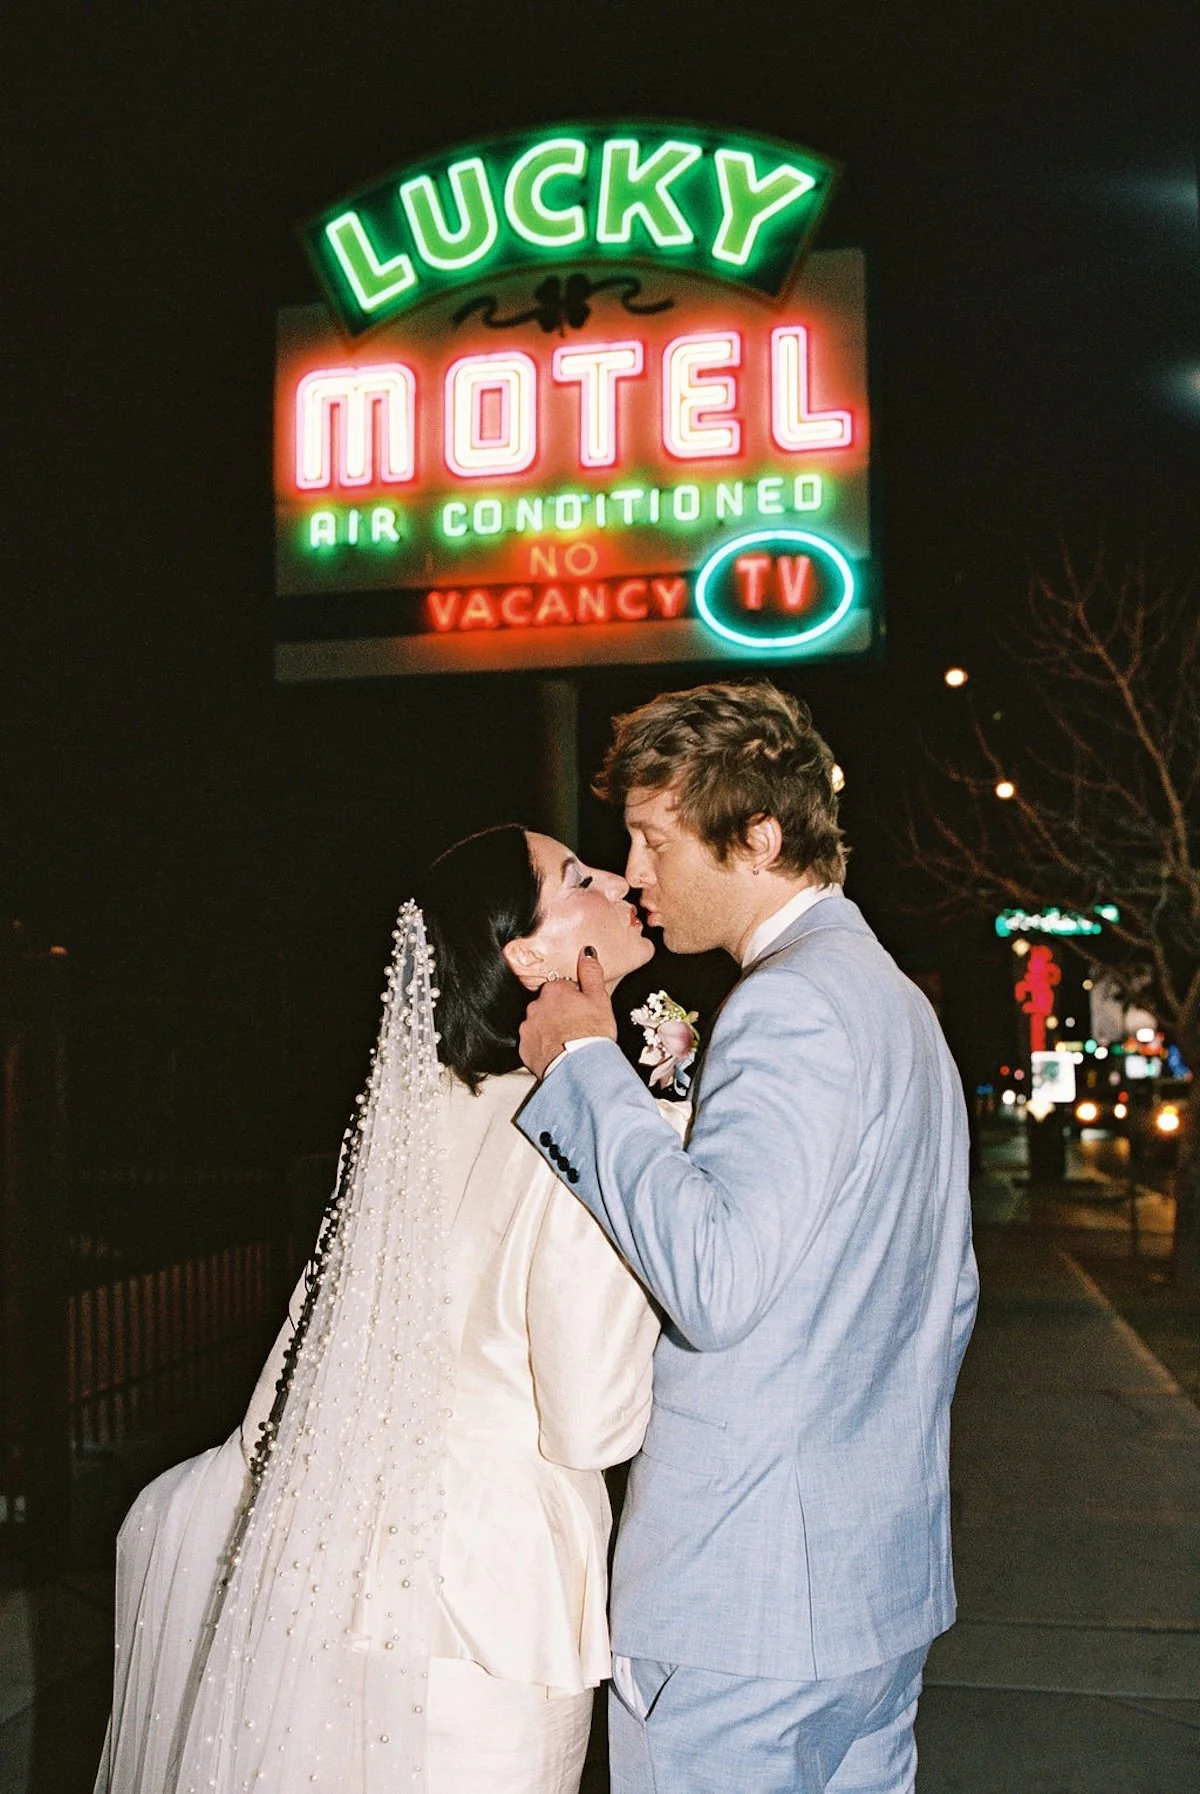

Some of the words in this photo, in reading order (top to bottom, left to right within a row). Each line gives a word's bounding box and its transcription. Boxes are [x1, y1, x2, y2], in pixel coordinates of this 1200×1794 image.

[325, 138, 816, 313] LUCKY
[296, 326, 852, 490] MOTEL
[309, 510, 401, 549] AIR
[442, 474, 824, 538] CONDITIONED
[530, 543, 598, 577] NO
[736, 555, 813, 610] TV
[429, 580, 687, 631] VACANCY
